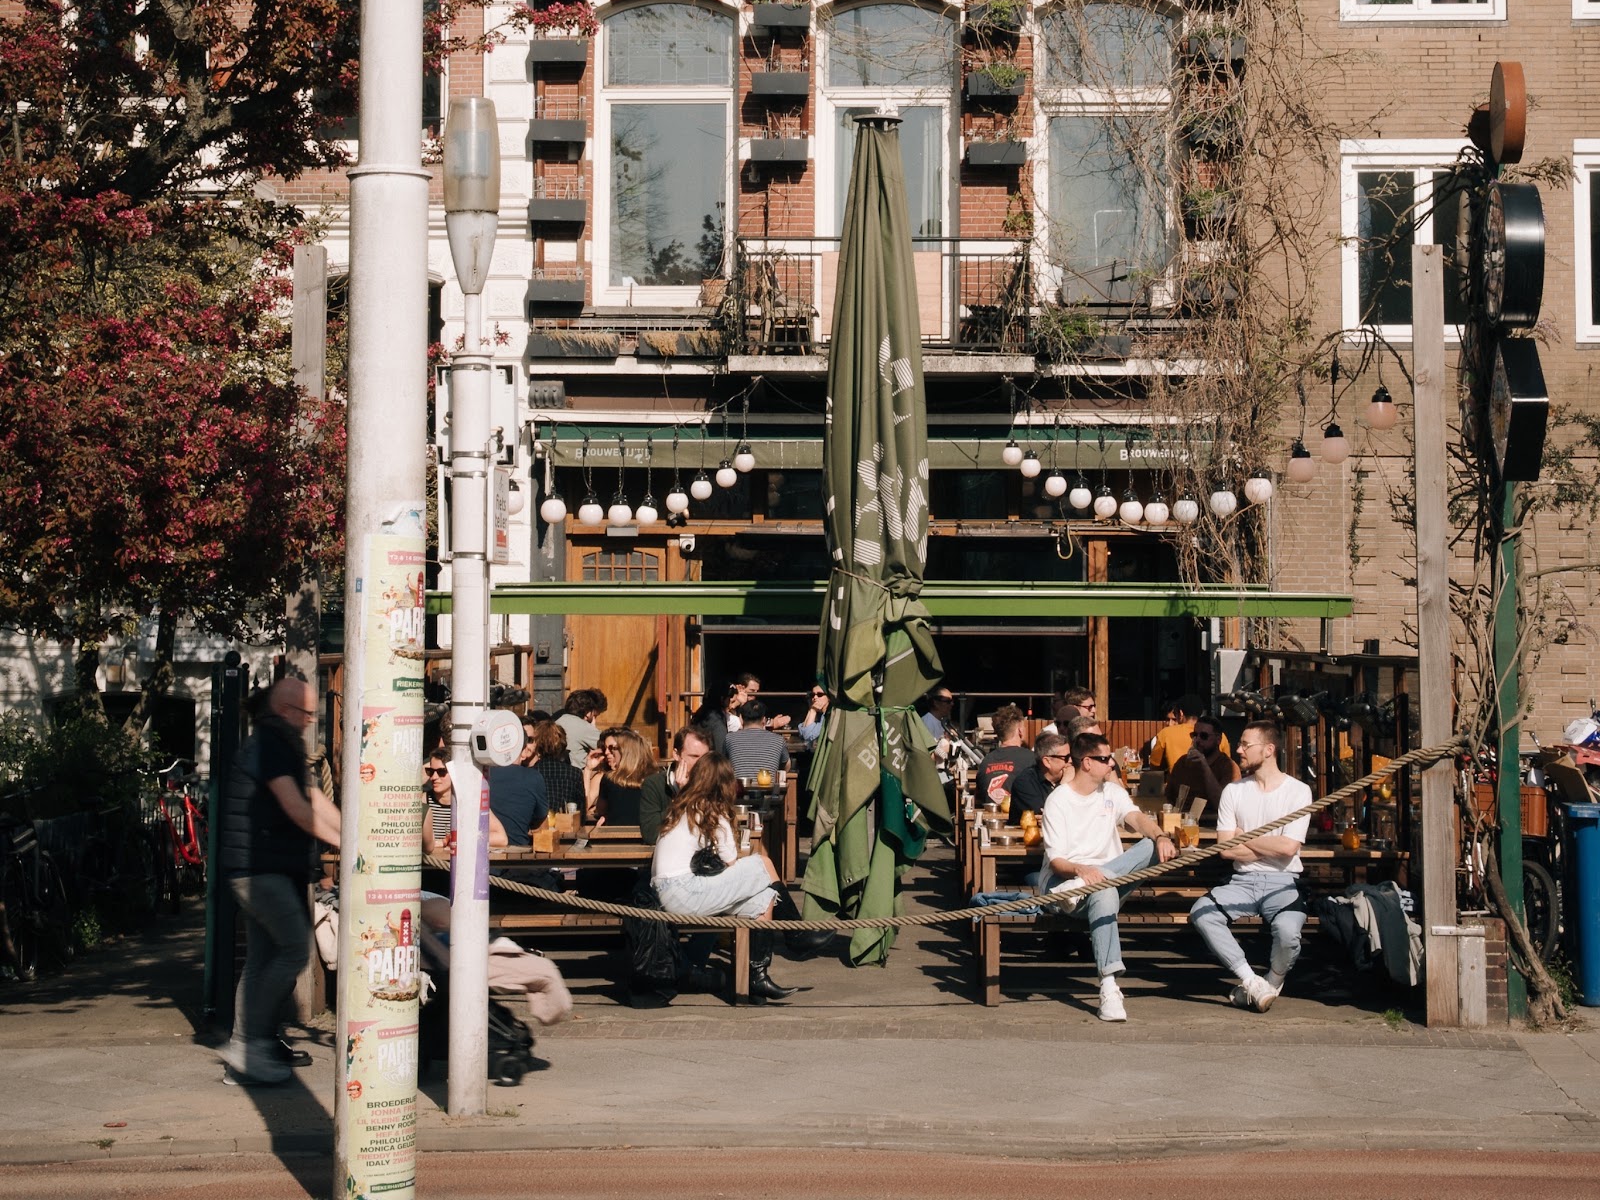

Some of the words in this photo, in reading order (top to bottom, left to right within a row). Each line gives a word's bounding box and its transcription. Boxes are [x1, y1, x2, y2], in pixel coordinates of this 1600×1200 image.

[575, 448, 633, 459] BROUWEIJ
[366, 1124, 396, 1132] BENNY
[370, 1137, 401, 1146] PHILOU
[360, 1145, 395, 1153] MONICA
[366, 1159, 390, 1167] IDALY
